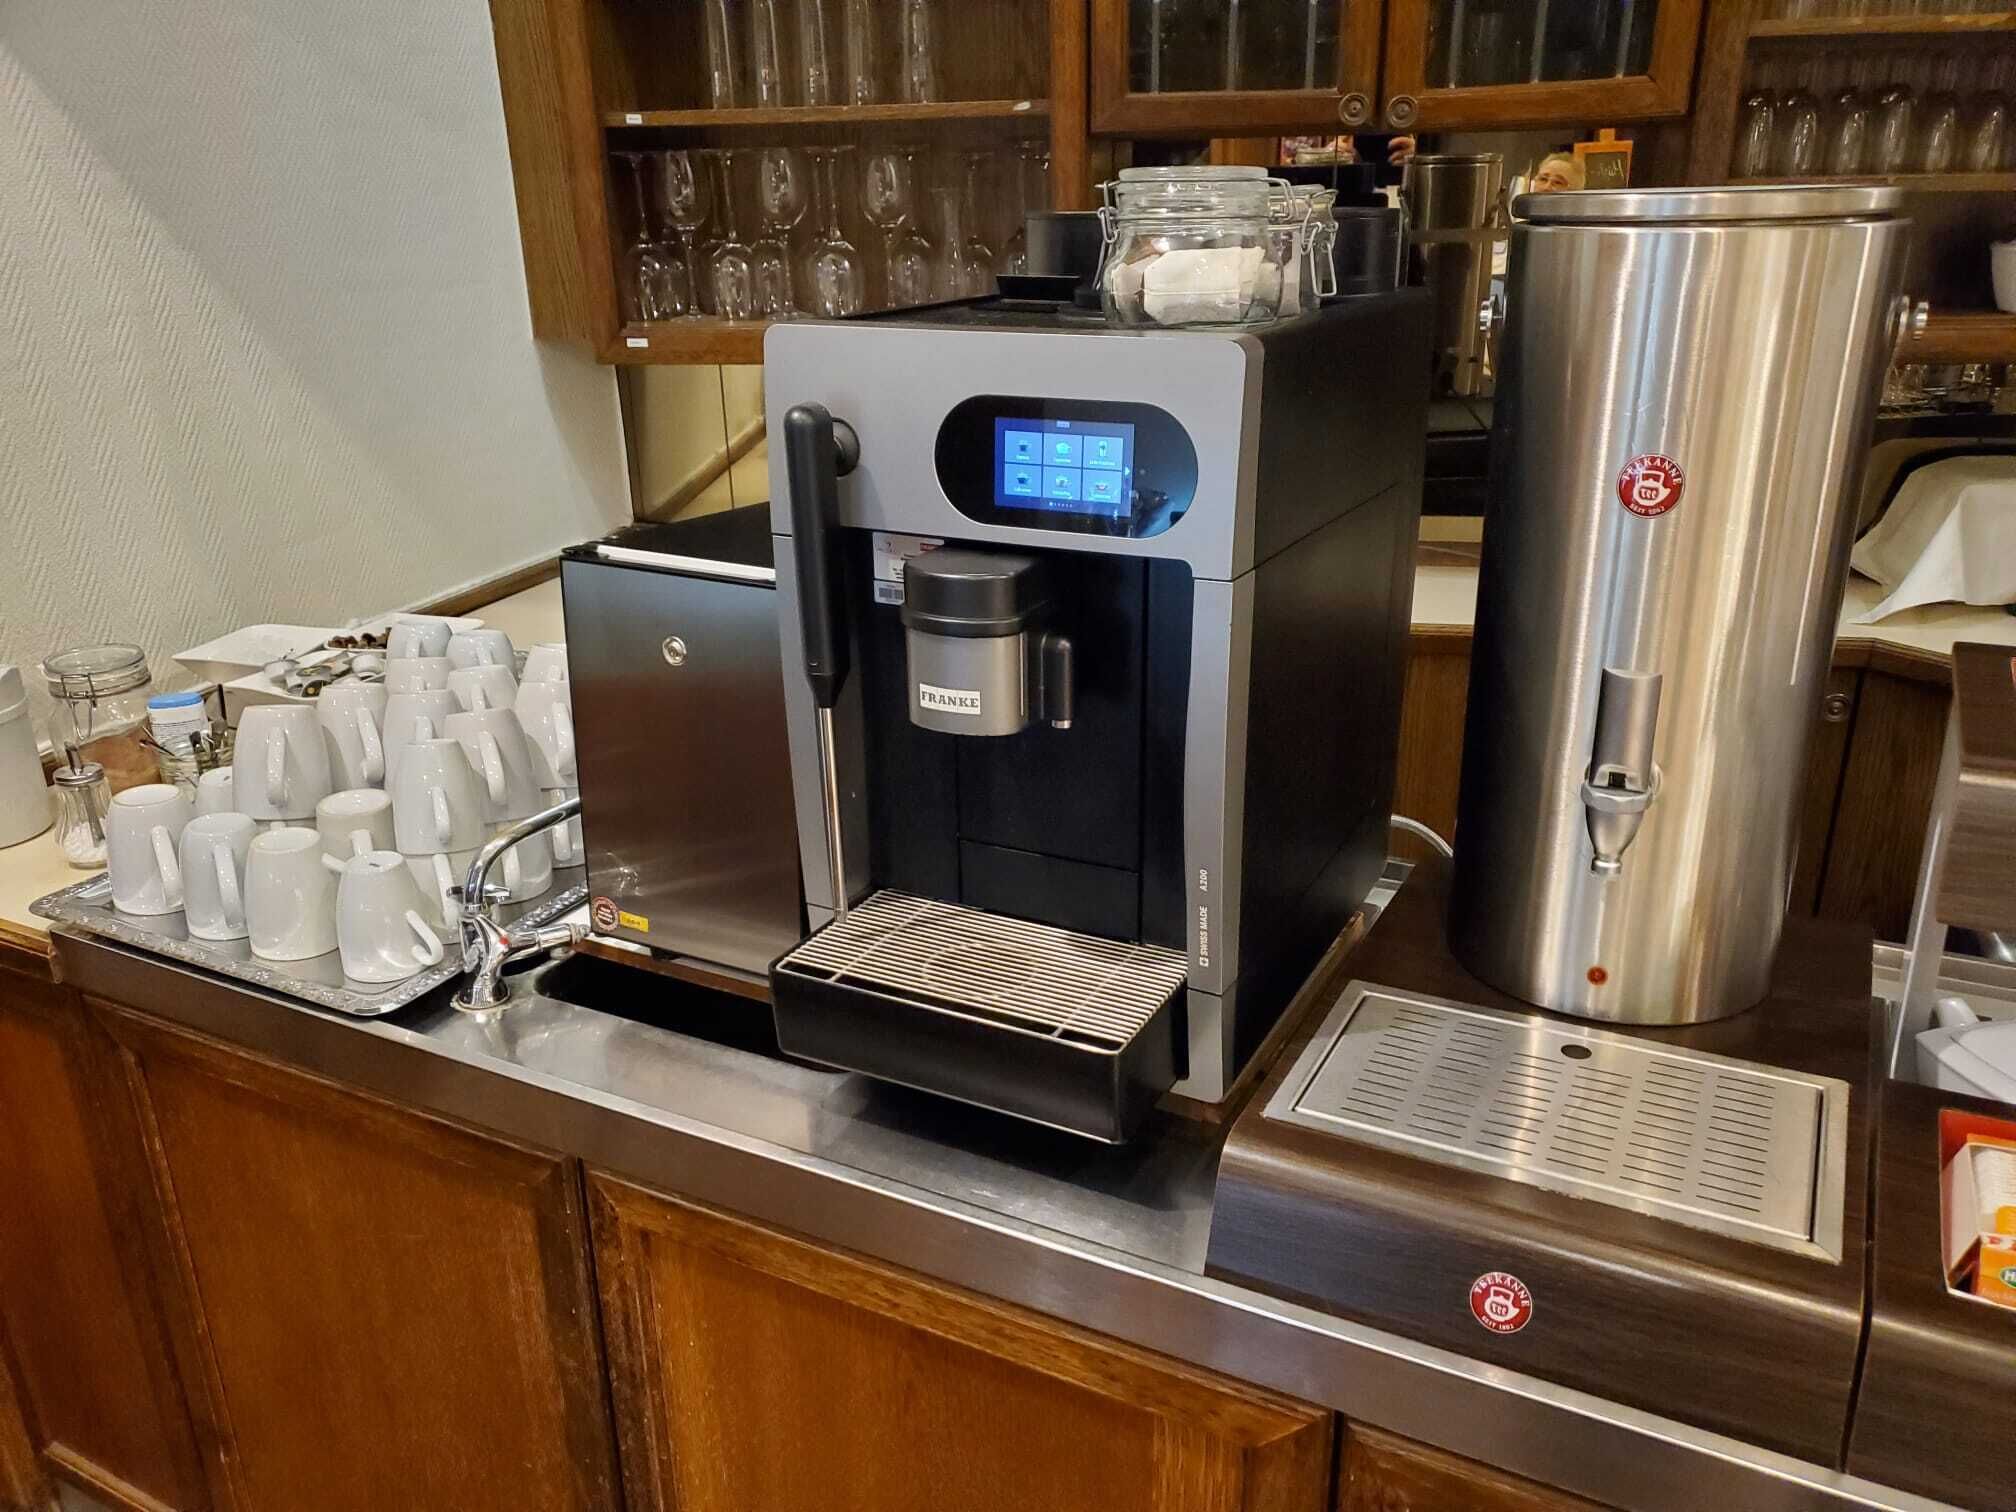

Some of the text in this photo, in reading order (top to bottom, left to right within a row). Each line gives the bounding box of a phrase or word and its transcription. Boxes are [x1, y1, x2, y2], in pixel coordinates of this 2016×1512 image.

[921, 691, 978, 707] FRANKE
[1199, 905, 1208, 957] SWISS MADE
